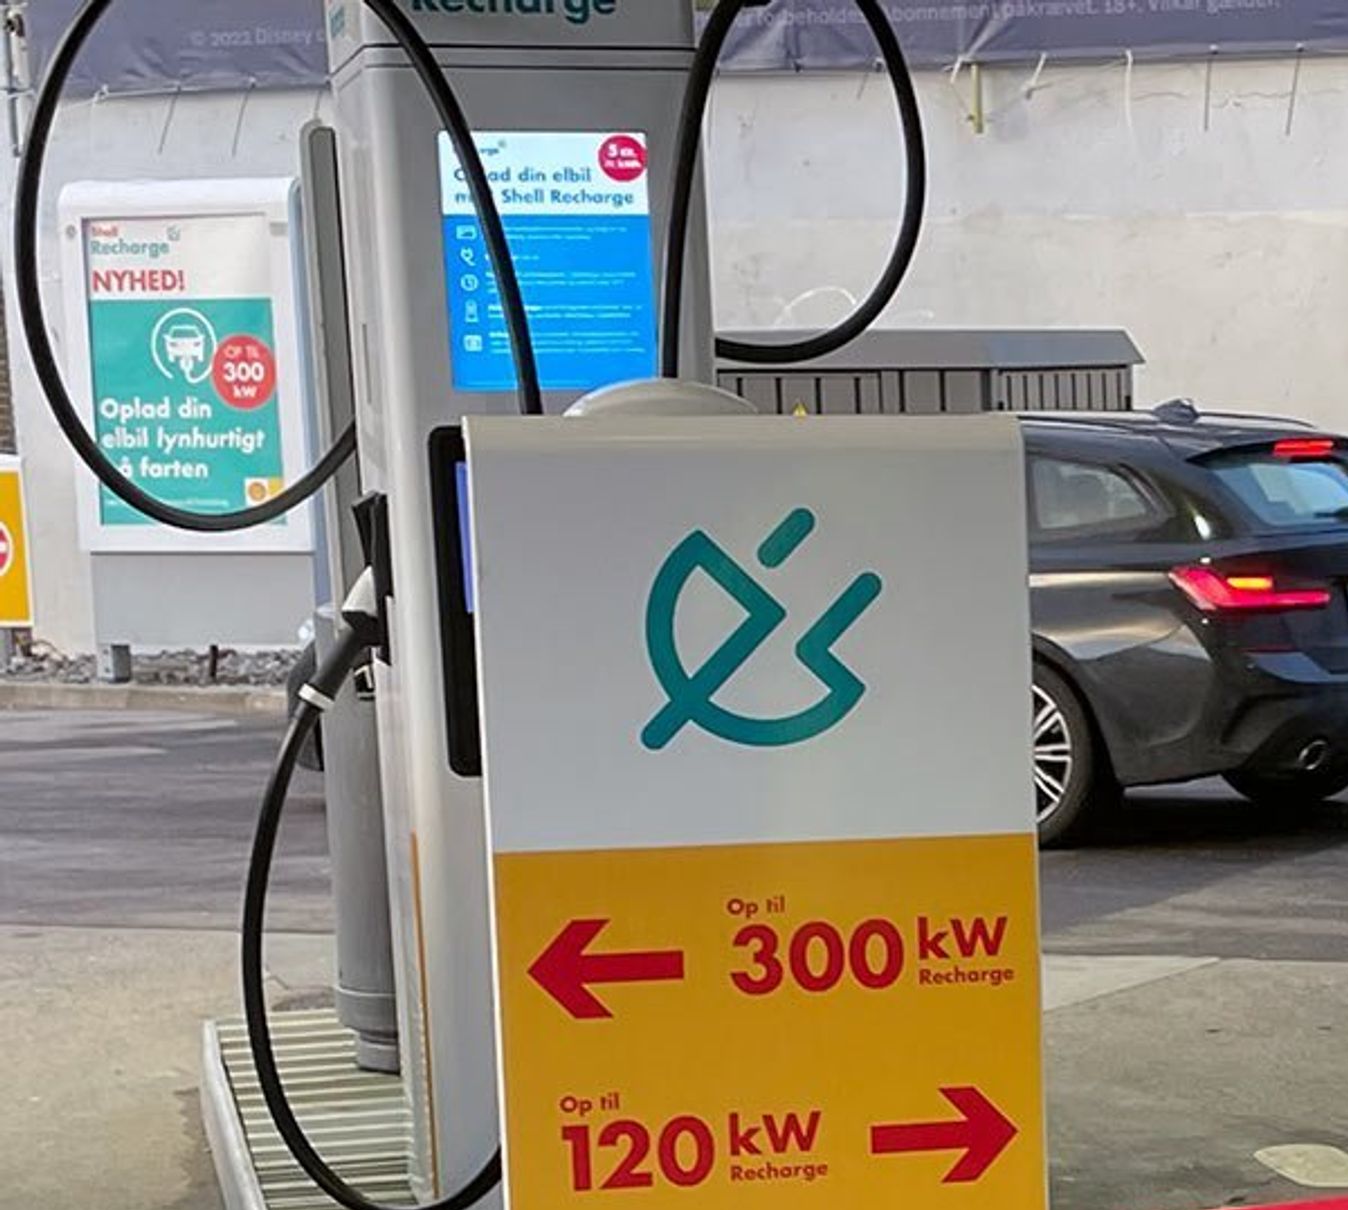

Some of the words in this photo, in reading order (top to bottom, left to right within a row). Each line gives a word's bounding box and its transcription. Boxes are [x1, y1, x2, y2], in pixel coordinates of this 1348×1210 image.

[882, 6, 999, 21] bonnement
[454, 167, 511, 183] Oad
[518, 167, 546, 183] din
[553, 167, 592, 183] elbil
[501, 188, 545, 205] Shell
[550, 188, 634, 207] Recharge
[90, 238, 170, 258] Recharge
[92, 269, 185, 292] NYHED!
[223, 361, 265, 382] 300
[100, 397, 171, 424] Oplad
[178, 396, 213, 419] din
[101, 426, 148, 448] elbil
[157, 426, 266, 454] lynhurtigt
[140, 456, 209, 478] farten
[726, 898, 758, 918] Op
[766, 896, 786, 914] til
[730, 918, 905, 996] 300
[916, 916, 1008, 960] kW
[919, 965, 1014, 986] Recharge
[559, 1095, 593, 1116] Op
[601, 1092, 620, 1111] til
[561, 1115, 716, 1192] 120
[728, 1110, 822, 1157] kW
[730, 1162, 828, 1182] Recharge
